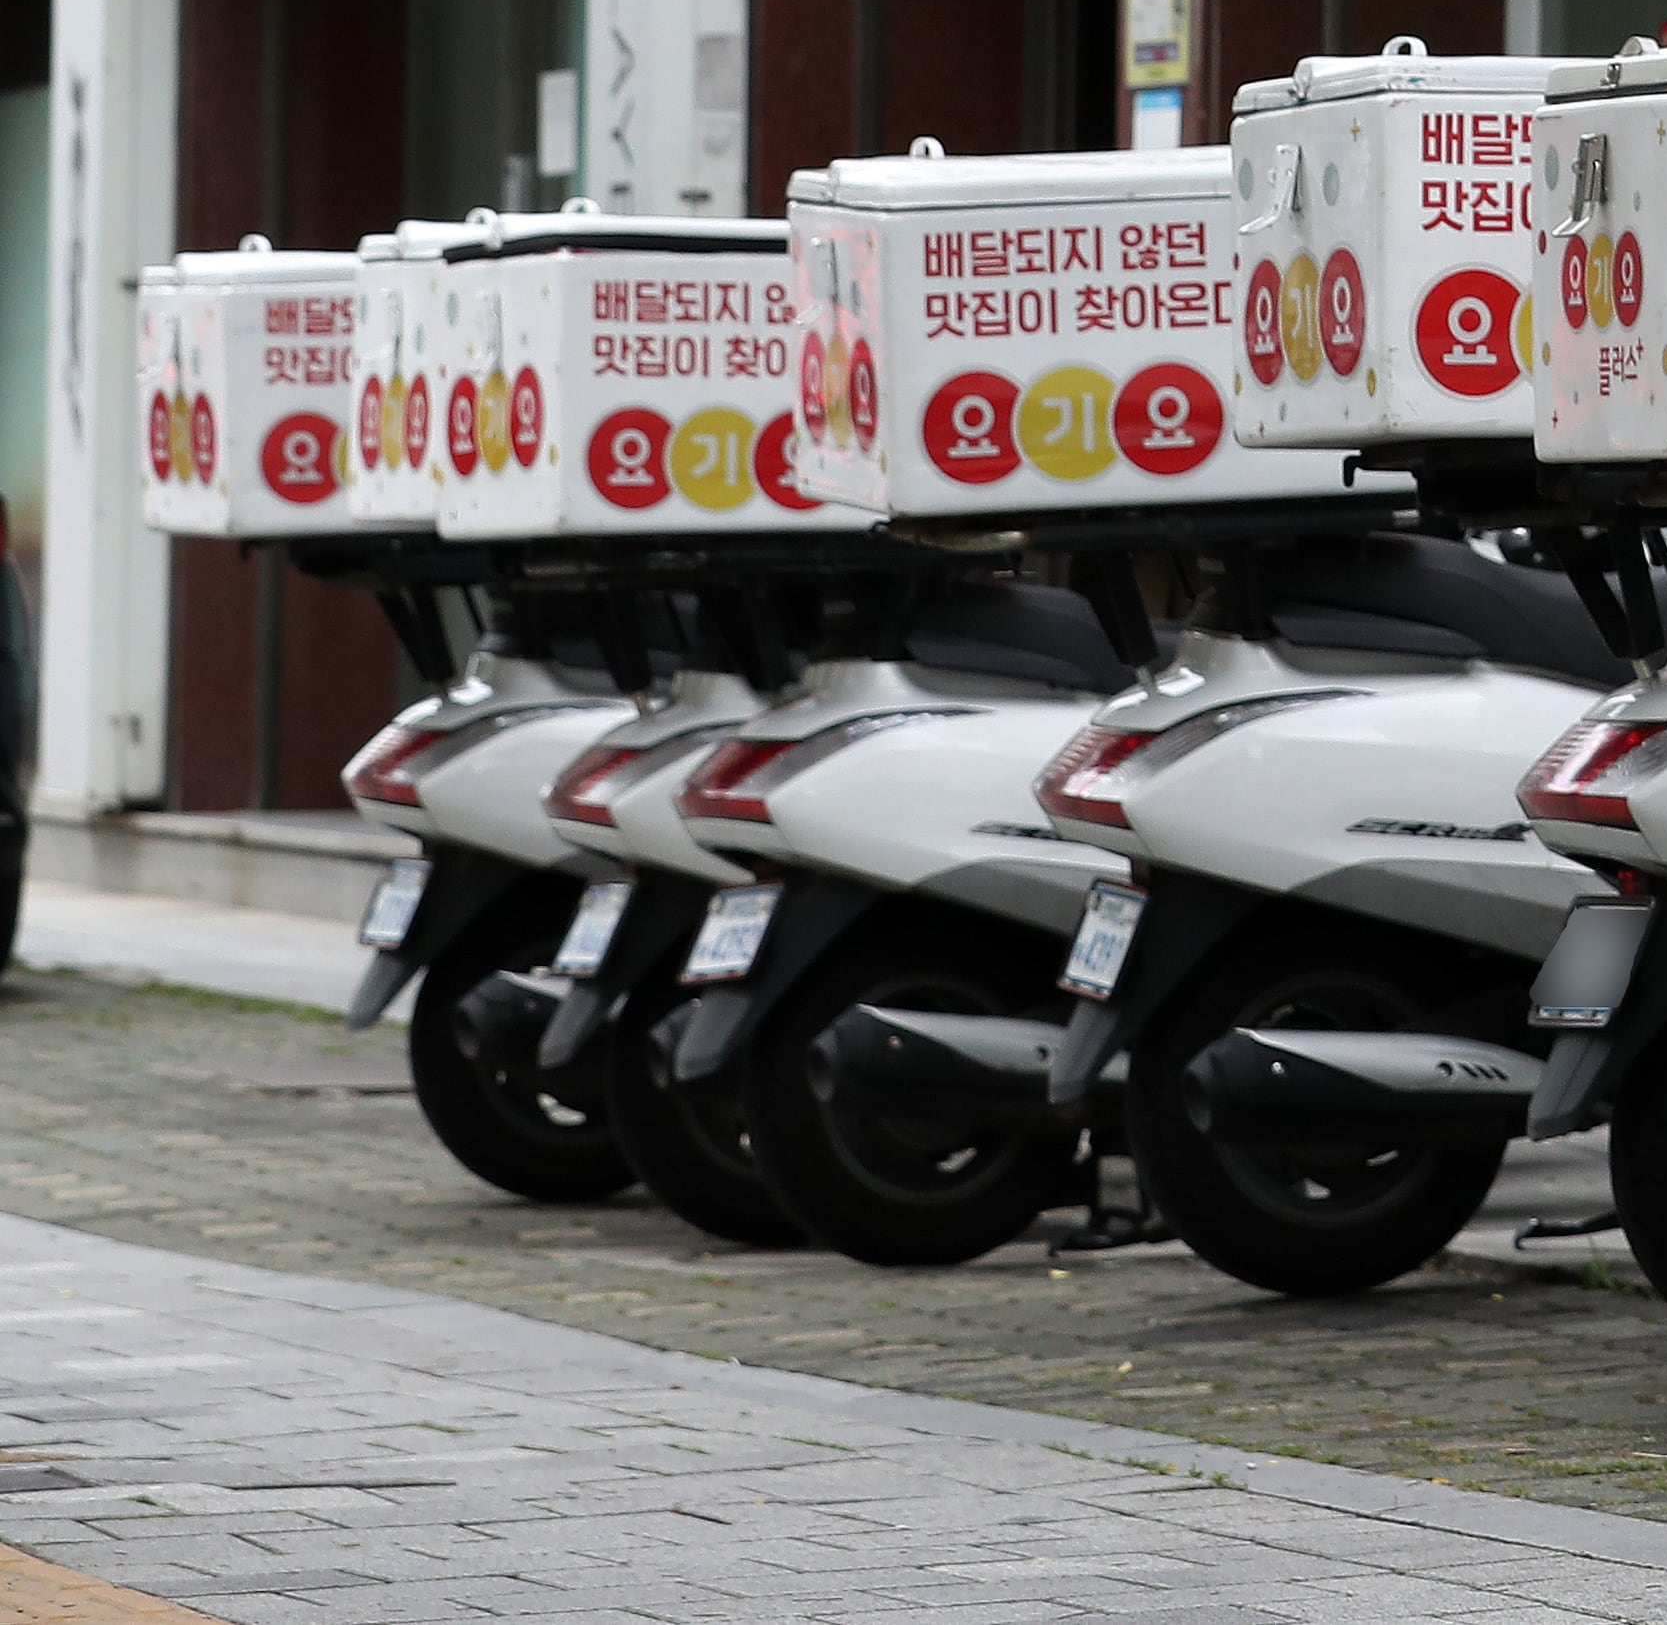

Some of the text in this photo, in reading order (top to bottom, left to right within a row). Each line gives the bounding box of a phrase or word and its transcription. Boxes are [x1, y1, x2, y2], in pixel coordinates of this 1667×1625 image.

[924, 221, 1207, 279] 배달되지 않던
[594, 280, 750, 324] 배달되지
[924, 288, 1058, 338] 맛집이
[594, 335, 711, 378] 맛집이
